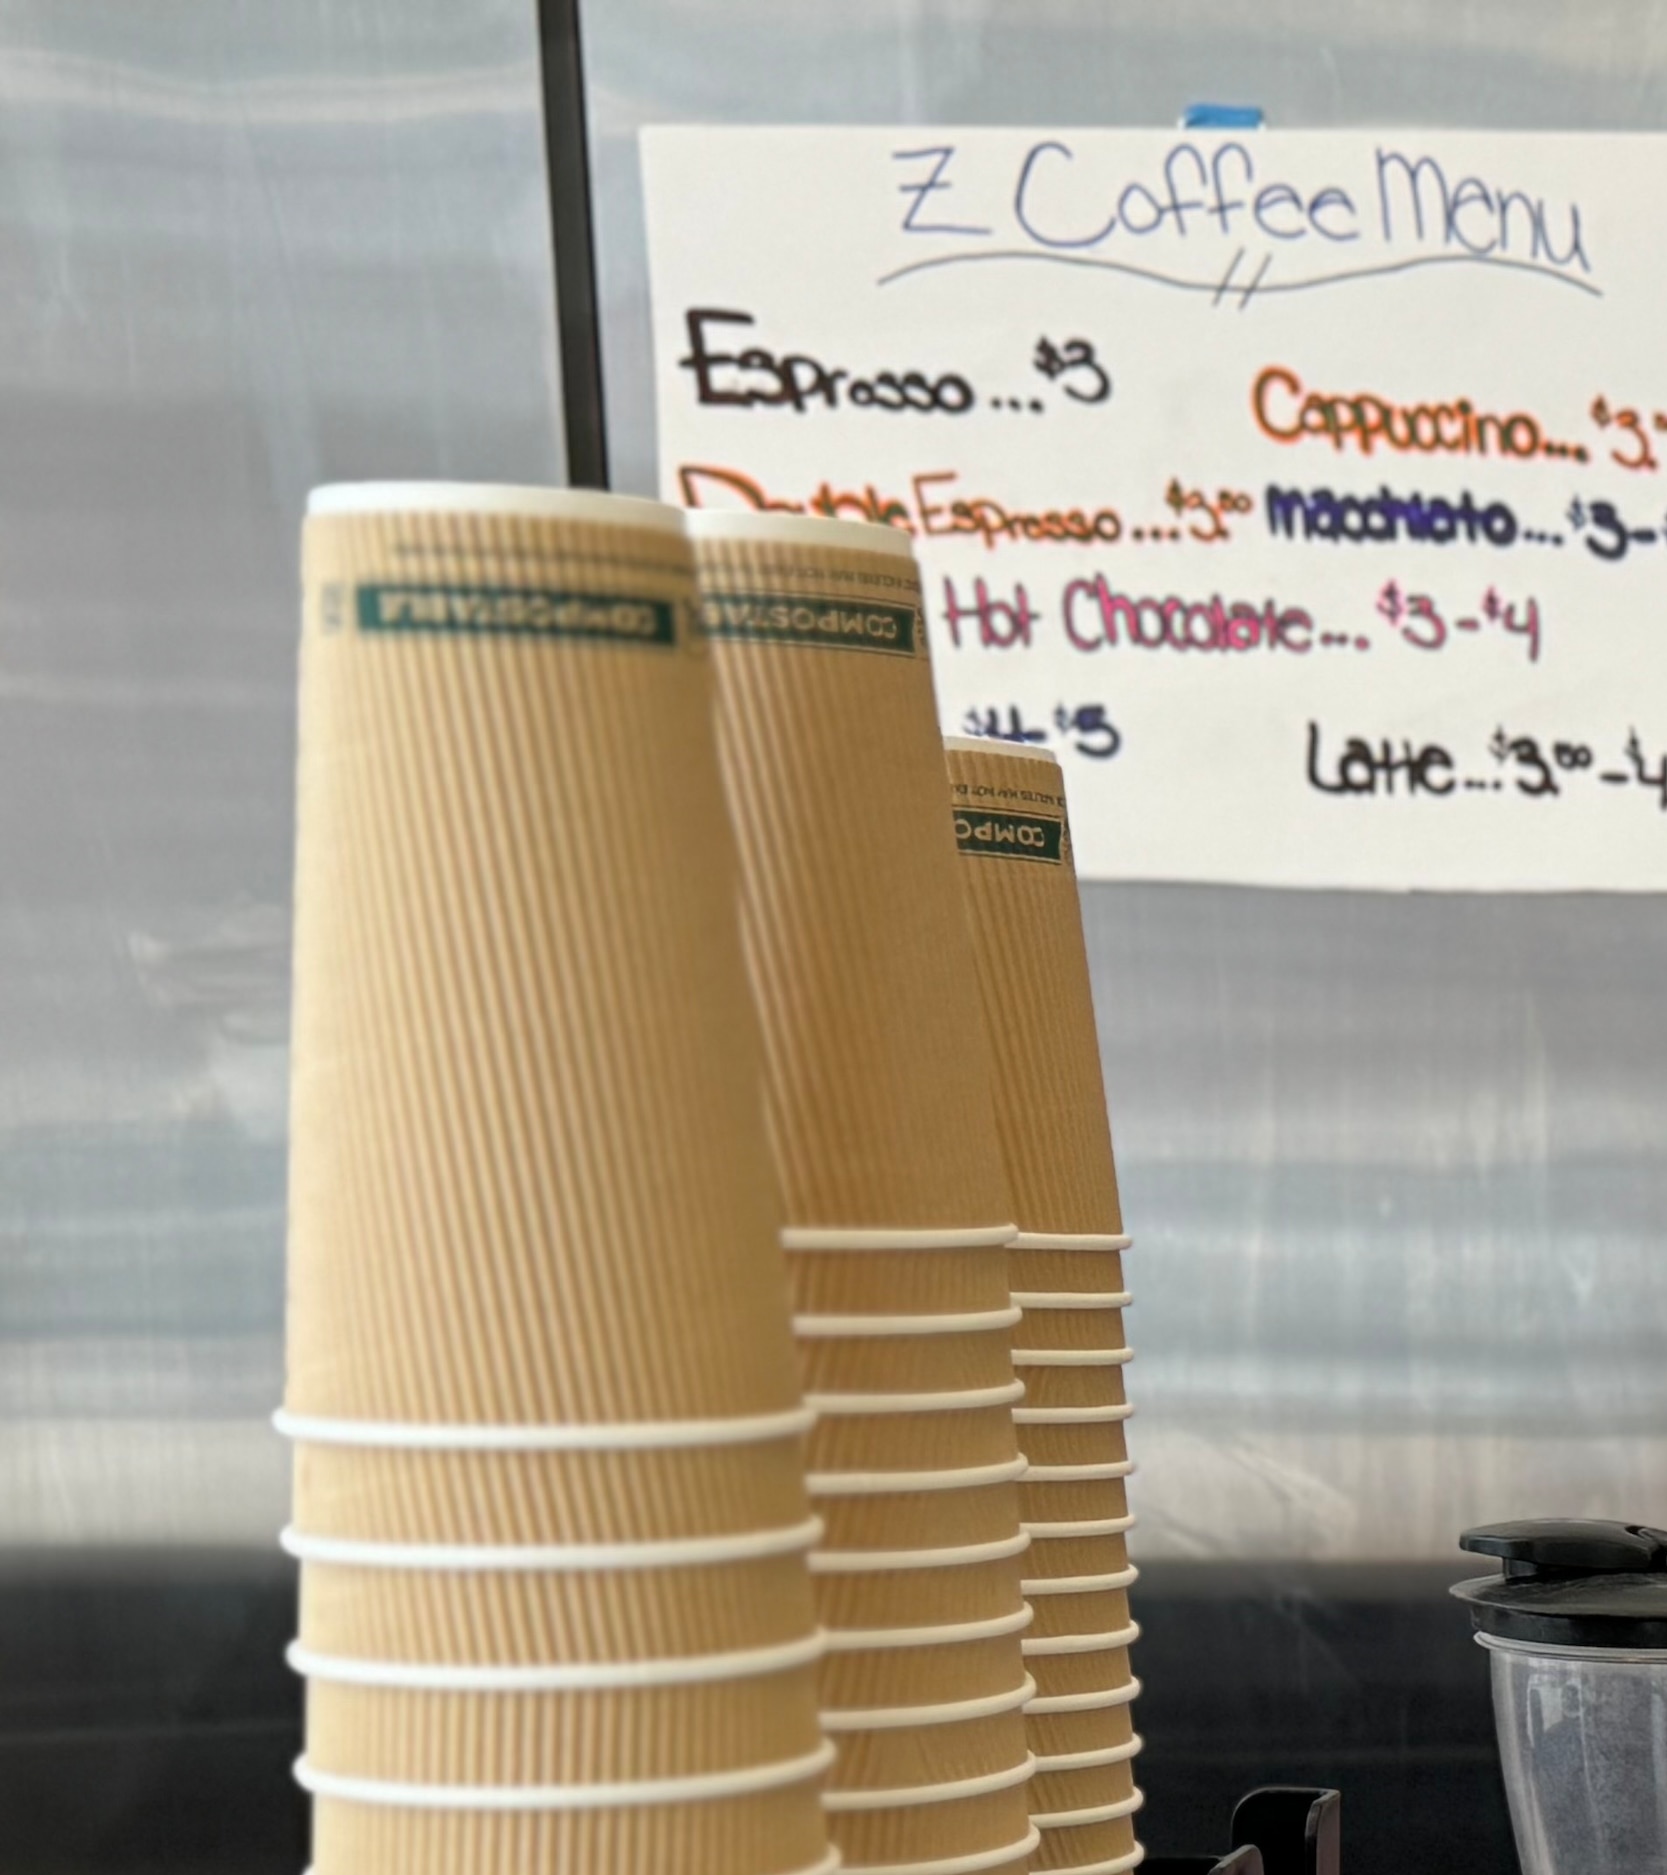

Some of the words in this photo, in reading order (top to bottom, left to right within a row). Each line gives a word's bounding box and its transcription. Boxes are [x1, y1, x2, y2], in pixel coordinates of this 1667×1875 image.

[892, 146, 993, 234] Z
[1016, 142, 1360, 248] Coffee
[1377, 146, 1591, 273] Menu
[941, 574, 1039, 648] Hot
